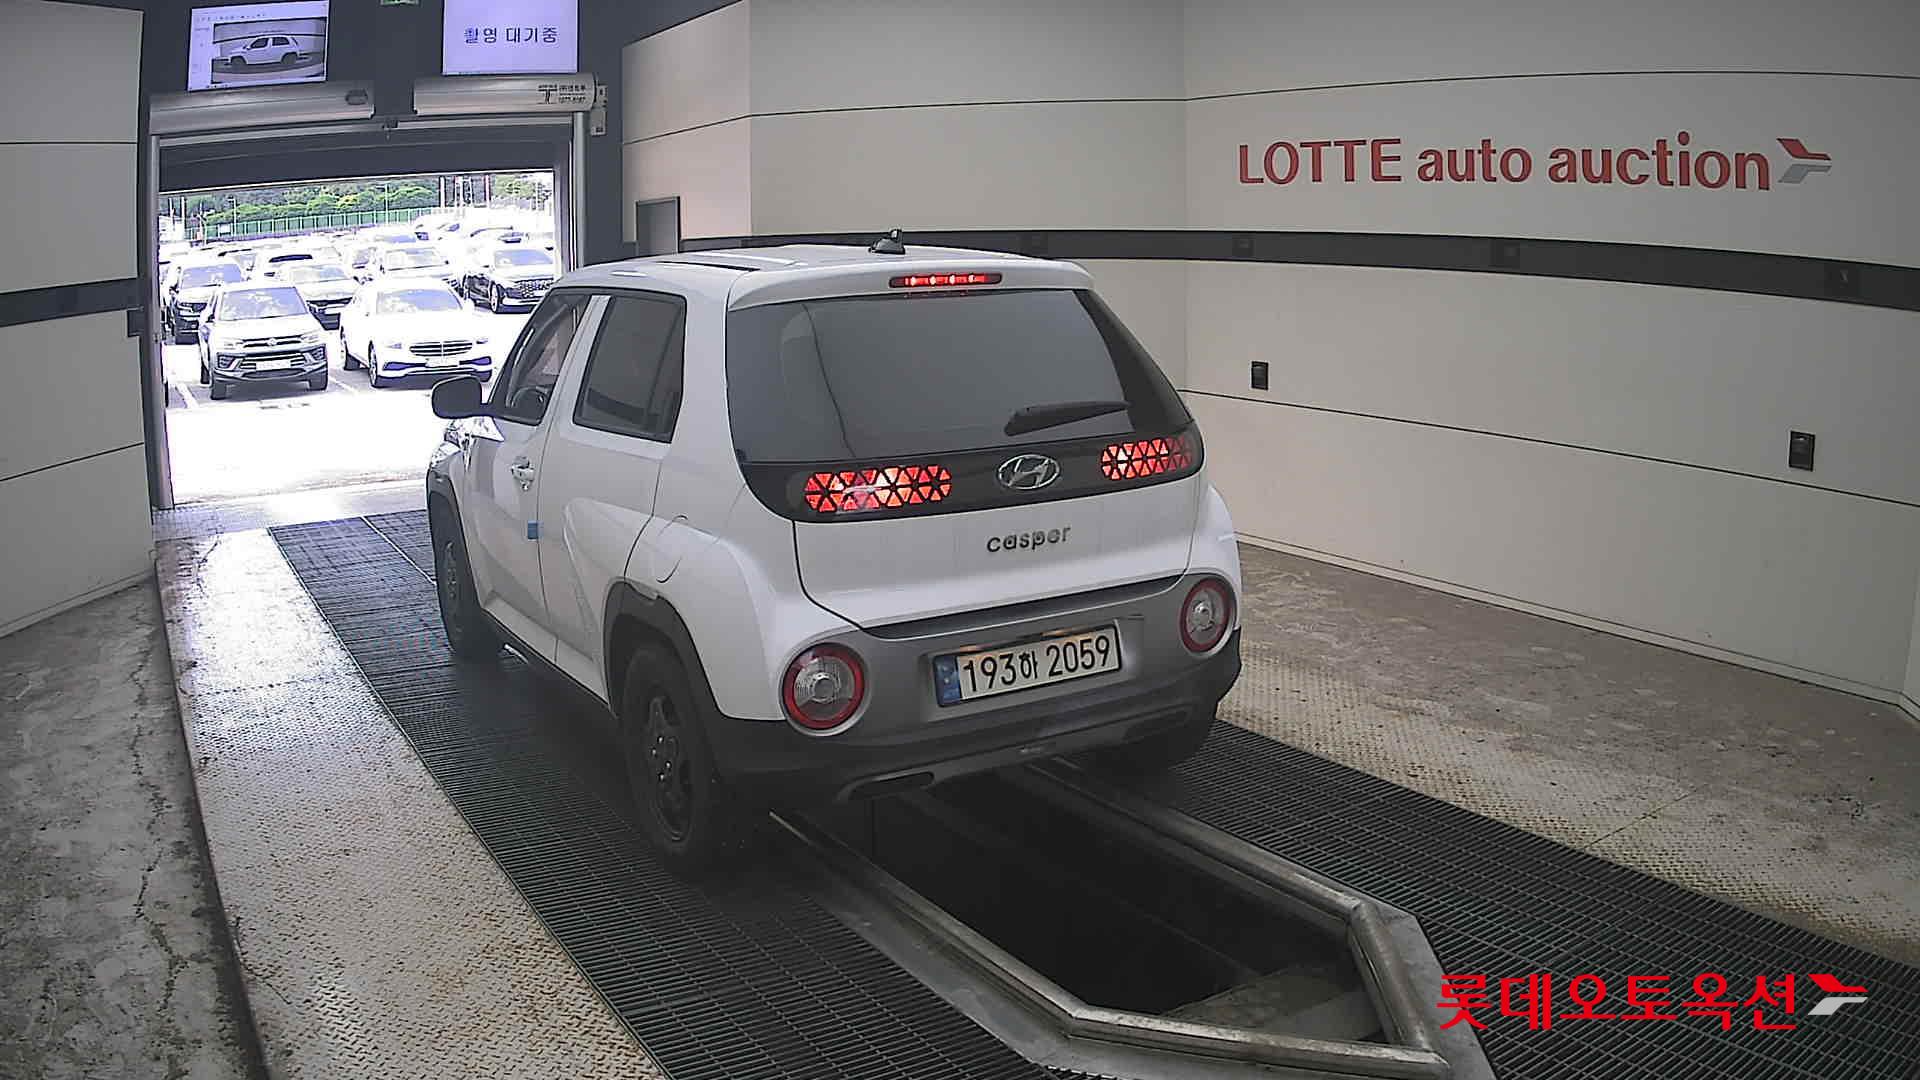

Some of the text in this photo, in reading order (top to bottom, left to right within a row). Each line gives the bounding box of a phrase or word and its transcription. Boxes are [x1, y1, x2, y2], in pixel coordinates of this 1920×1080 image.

[506, 27, 559, 44] 대기중
[1239, 130, 1771, 191] LOTTE auto auction
[986, 526, 1072, 553] casper
[963, 635, 1110, 692] 193하 2059
